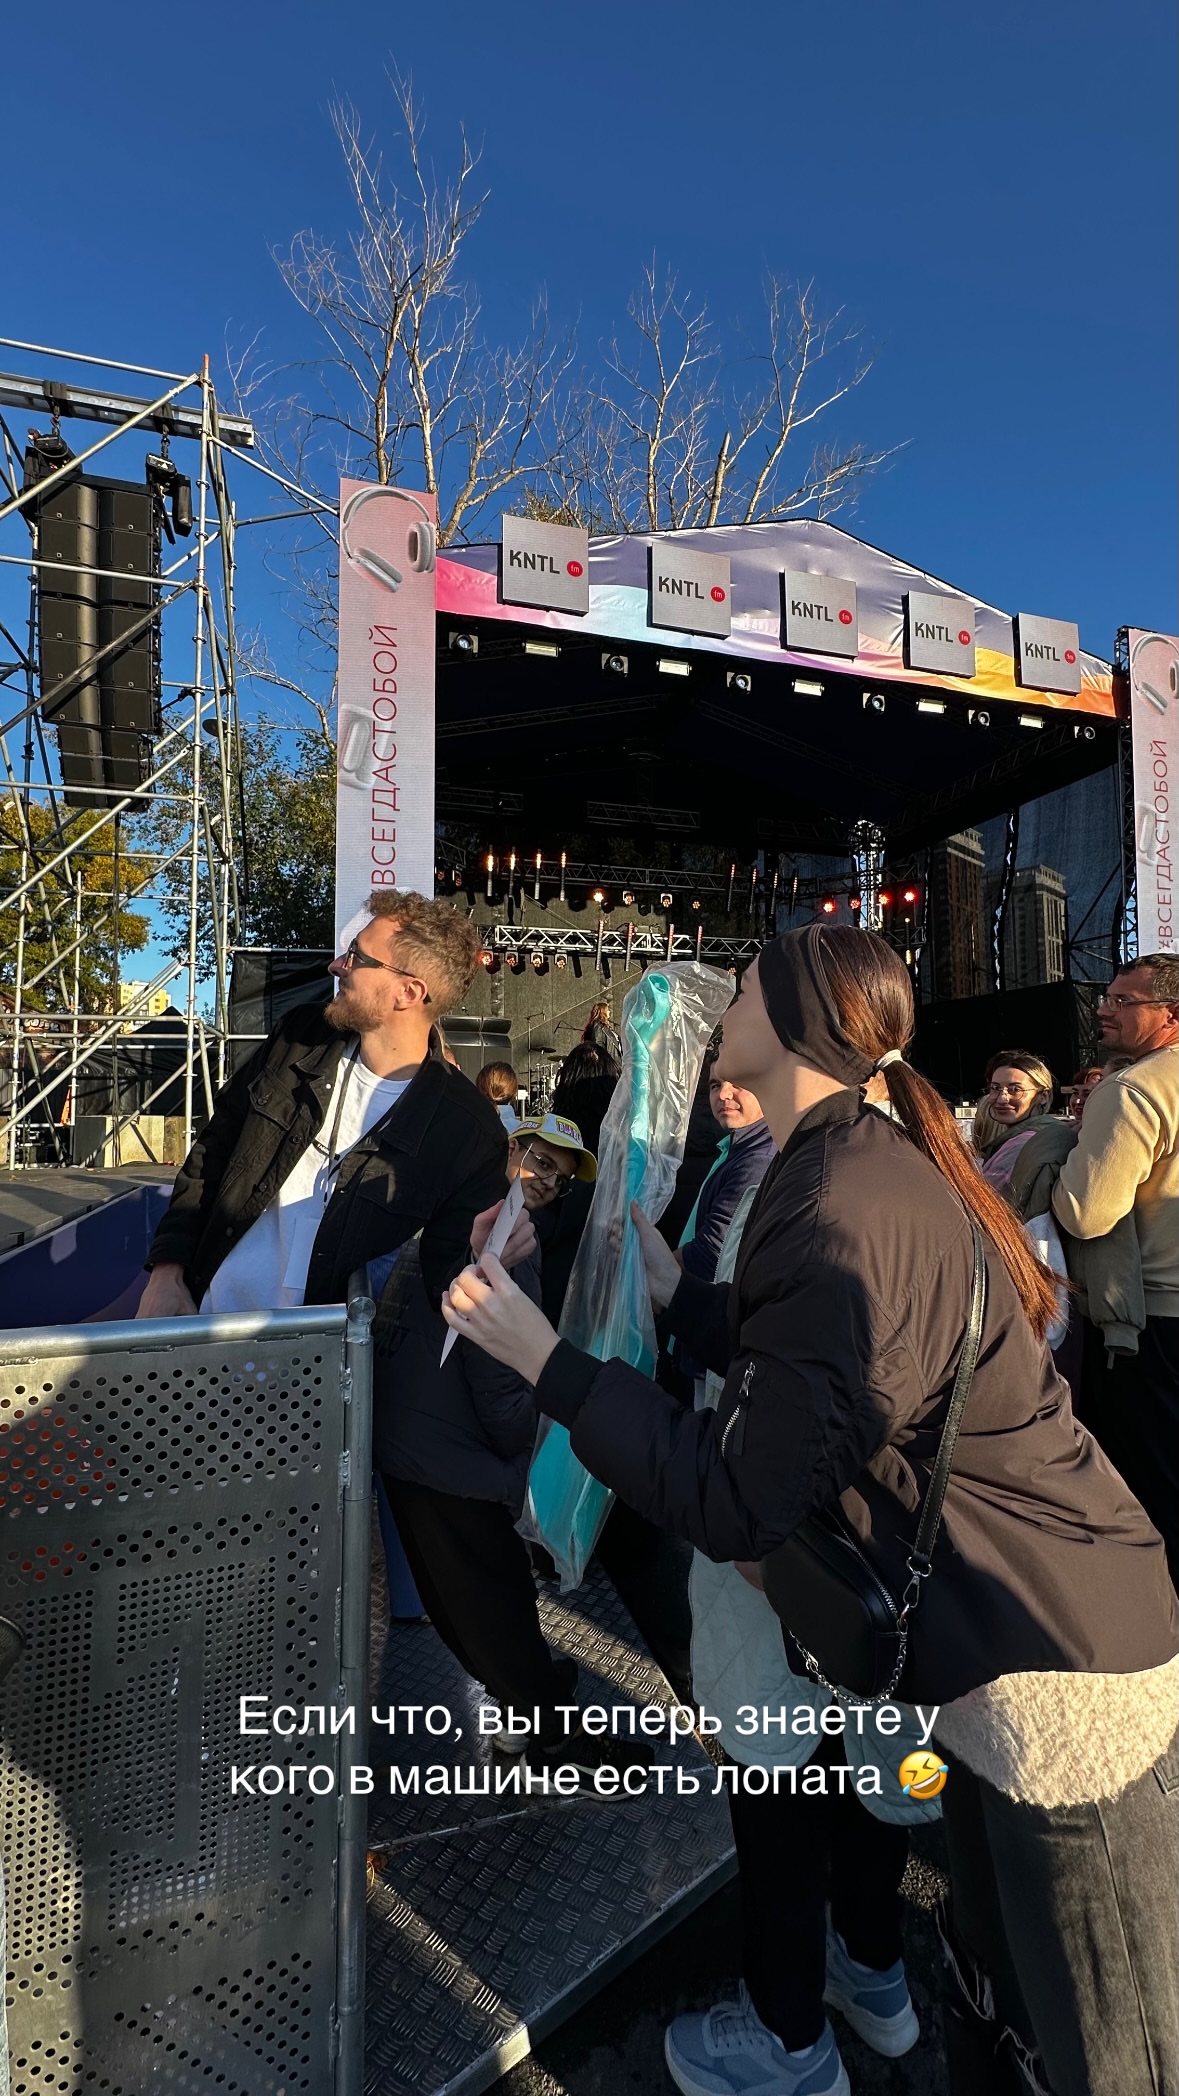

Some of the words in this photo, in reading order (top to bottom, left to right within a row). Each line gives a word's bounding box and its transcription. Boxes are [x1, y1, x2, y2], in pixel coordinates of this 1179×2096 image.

[509, 549, 561, 575] KNTL
[658, 575, 705, 600] KNTL
[791, 600, 834, 623] KNTL
[914, 621, 954, 644] KNTL
[1024, 641, 1061, 663] KNTL
[369, 624, 401, 886] ВСЕГДАСТОБОЙ
